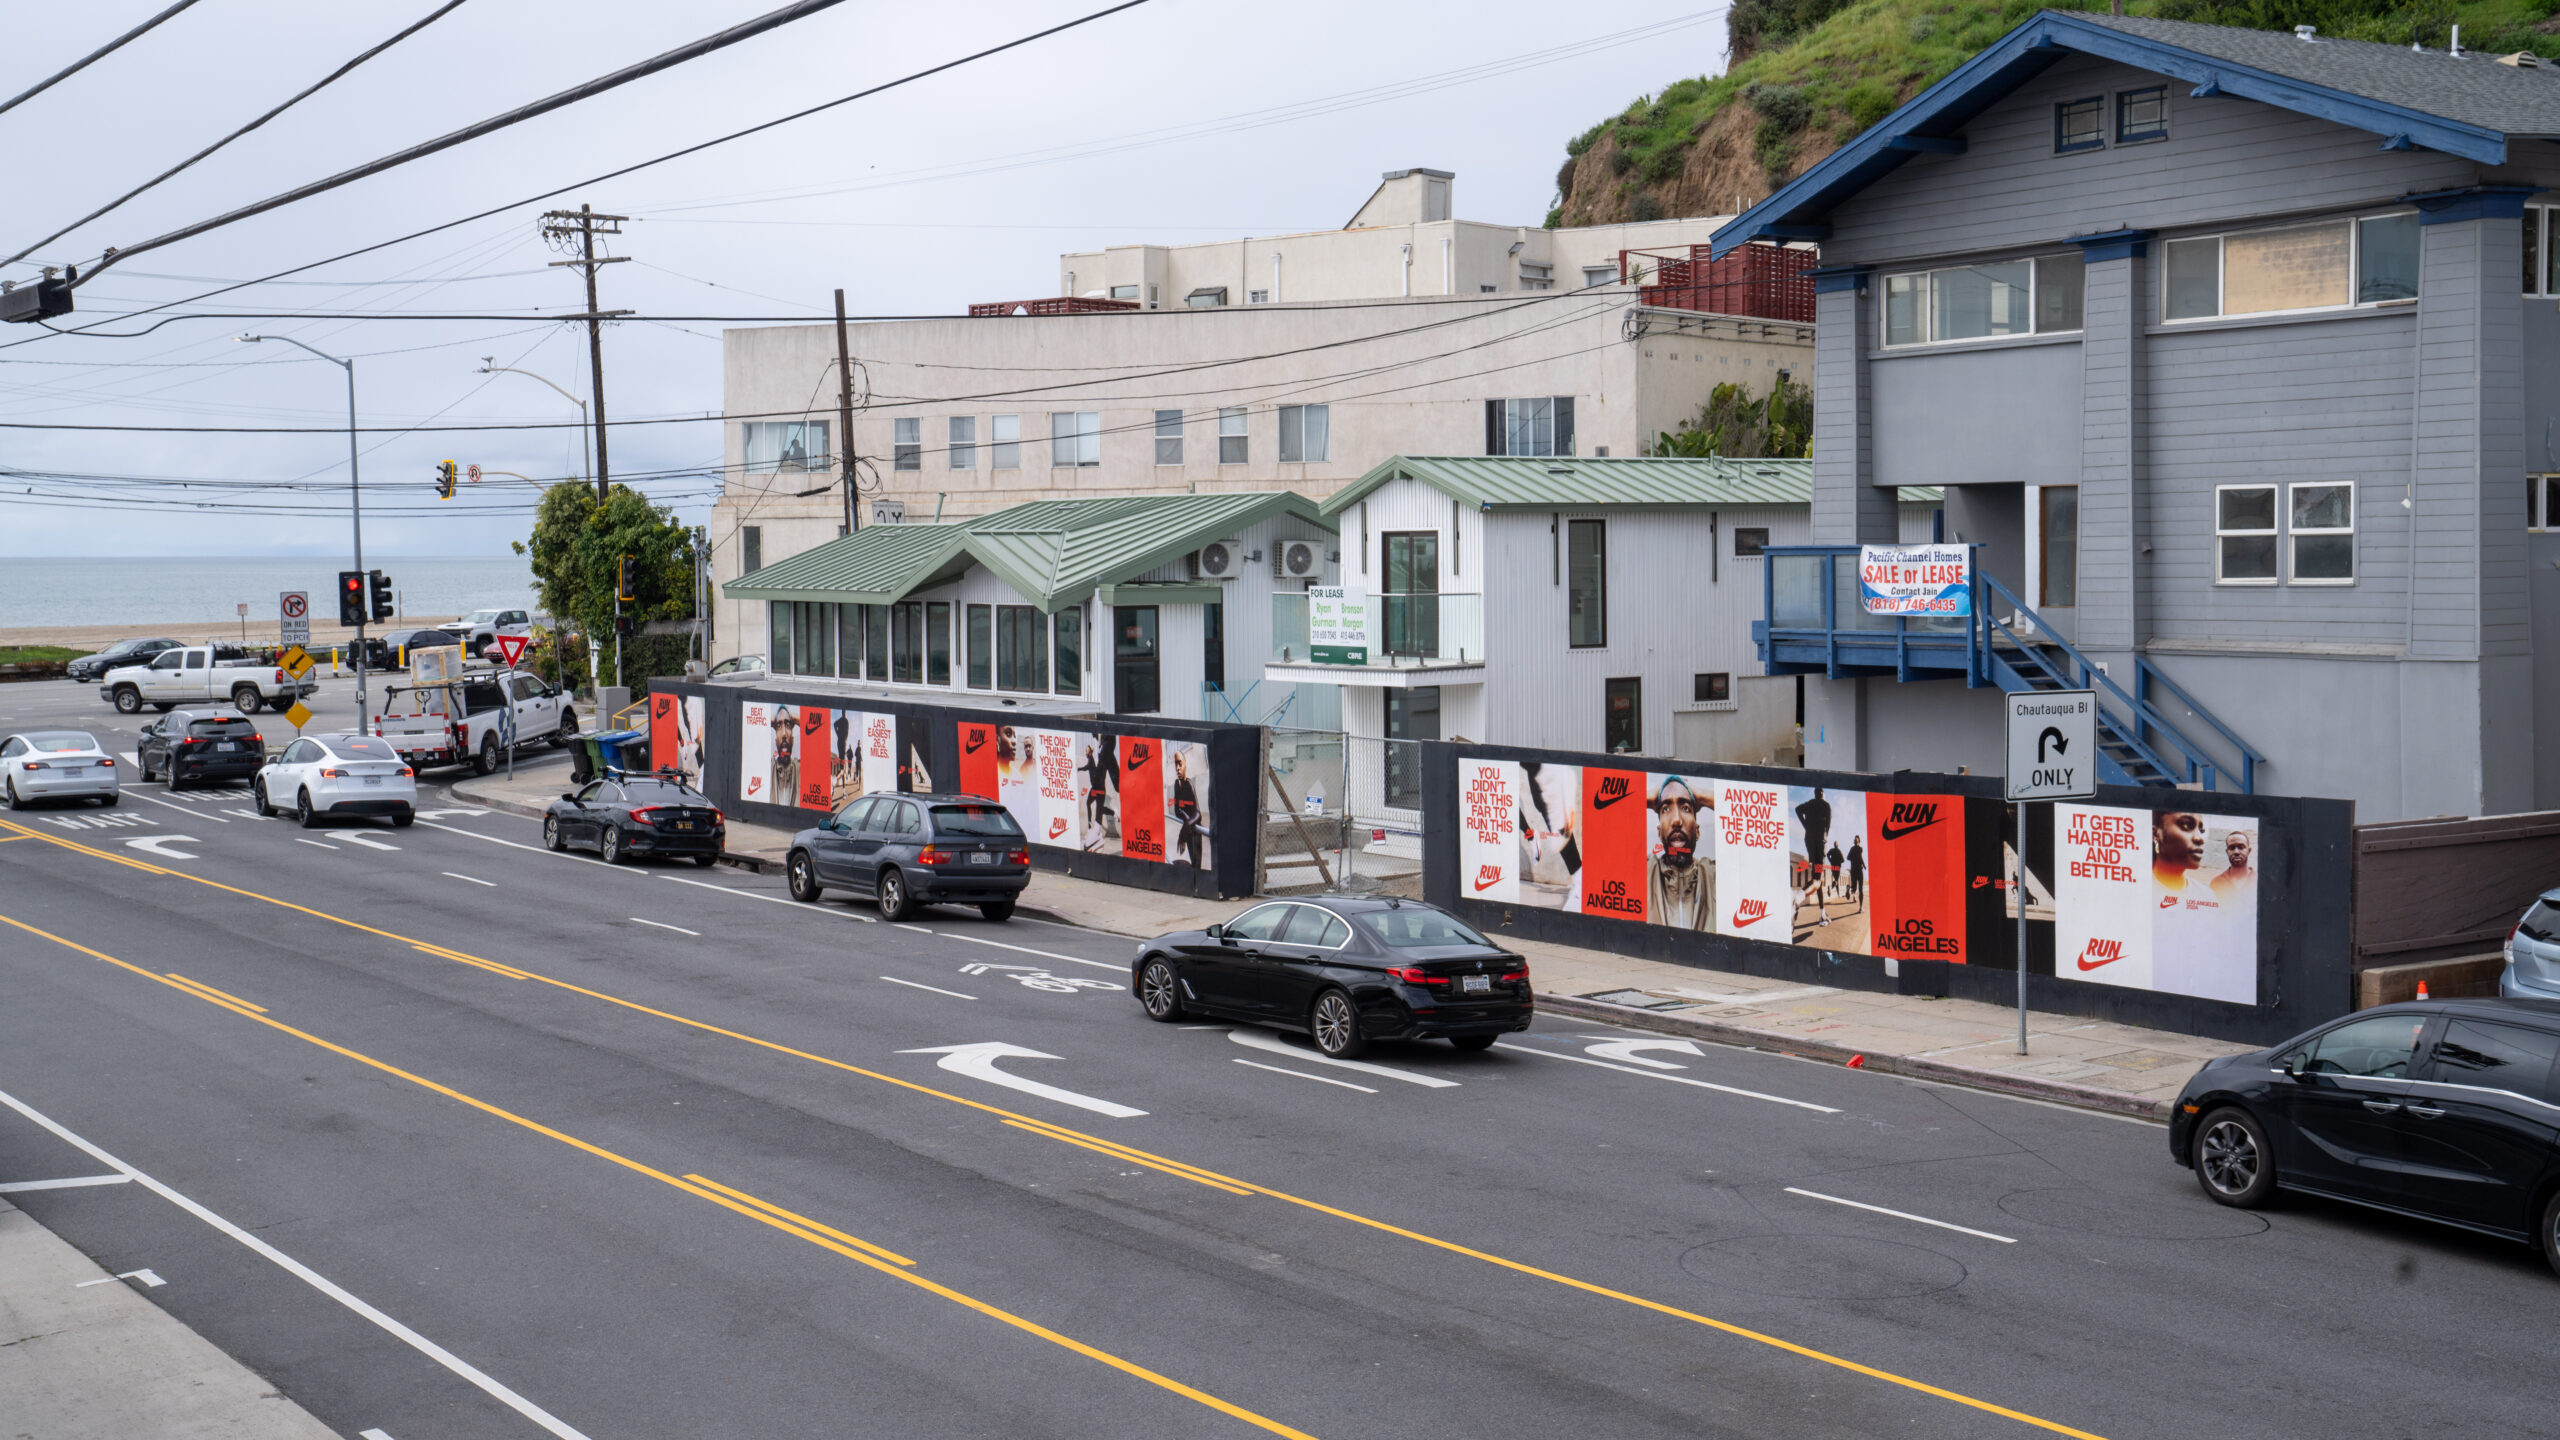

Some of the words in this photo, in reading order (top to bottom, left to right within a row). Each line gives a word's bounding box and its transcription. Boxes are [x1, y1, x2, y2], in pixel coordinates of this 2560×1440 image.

[1867, 552, 1894, 563] Pacific
[1896, 551, 1932, 563] Channel
[1934, 551, 1963, 562] Homes
[1863, 564, 1899, 584] SALE
[1904, 568, 1918, 584] or
[1922, 565, 1964, 584] LEASE
[1310, 589, 1324, 598] FOR
[1326, 589, 1344, 598] LEASE
[1891, 587, 1920, 596] Contact
[1922, 587, 1938, 596] Jain
[1316, 602, 1331, 616] Ryan
[1341, 602, 1364, 614] Bronson
[1869, 597, 1900, 612] (818)
[1904, 598, 1956, 612] 746-6435
[1312, 616, 1337, 627] Gurman
[1342, 617, 1364, 631] Morgan
[1347, 652, 1362, 660] CBRE
[659, 698, 670, 709] RUN
[2016, 704, 2074, 717] Chautauqua
[751, 707, 763, 717] BEAT
[808, 712, 822, 725] RUN
[746, 716, 767, 726] TRAFFIC.
[868, 728, 891, 740] EASIEST
[969, 729, 985, 742] RUN
[1039, 735, 1052, 746] THE
[1054, 736, 1071, 747] ONLY
[873, 738, 885, 748] 26.2
[870, 748, 889, 759] MILES.
[1046, 746, 1066, 757] THING
[1133, 744, 1149, 758] RUN
[1040, 756, 1054, 766] YOU
[1056, 758, 1072, 769] NEED
[1042, 767, 1049, 776] IS
[1050, 767, 1071, 779] EVERY
[1477, 767, 1500, 780] YOU
[2032, 768, 2074, 787] ONLY
[751, 776, 762, 787] RUN
[1047, 777, 1068, 789] THING
[1472, 779, 1506, 793] DIDN'T
[1601, 777, 1629, 796] RUN
[810, 784, 821, 794] LOS
[1041, 788, 1054, 799] YOU
[802, 794, 828, 806] ANGELES
[1466, 792, 1487, 805] RUN
[1490, 794, 1513, 807] THIS
[1724, 788, 1778, 807] ANYONE
[1471, 805, 1491, 818] FAR
[1493, 807, 1508, 820] TO
[1730, 803, 1771, 819] KNOW
[1890, 803, 1938, 823] RUN
[37, 812, 160, 830] WAIT
[1053, 817, 1067, 829] RUN
[1466, 817, 1487, 830] RUN
[1490, 819, 1513, 833] THIS
[1720, 815, 1743, 832] THE
[1746, 819, 1785, 836] PRICE
[2072, 813, 2087, 829] IT
[2090, 814, 2134, 833] GETS
[1135, 828, 1151, 841] LOS
[1478, 831, 1501, 845] FAR.
[1725, 831, 1742, 845] OF
[1744, 834, 1779, 850] GAS?
[2067, 829, 2139, 850] HARDER.
[1126, 839, 1162, 856] ANGELES
[2085, 847, 2121, 865] AND
[1479, 865, 1502, 881] RUN
[2070, 862, 2137, 883] BETTER.
[1602, 880, 1626, 896] LOS
[1587, 894, 1642, 914] ANGELES
[2164, 896, 2178, 904] RUN
[1739, 899, 1767, 916] RUN
[1895, 919, 1934, 935] LOS
[1877, 933, 1959, 955] ANGELES
[2086, 938, 2123, 959] RUN
